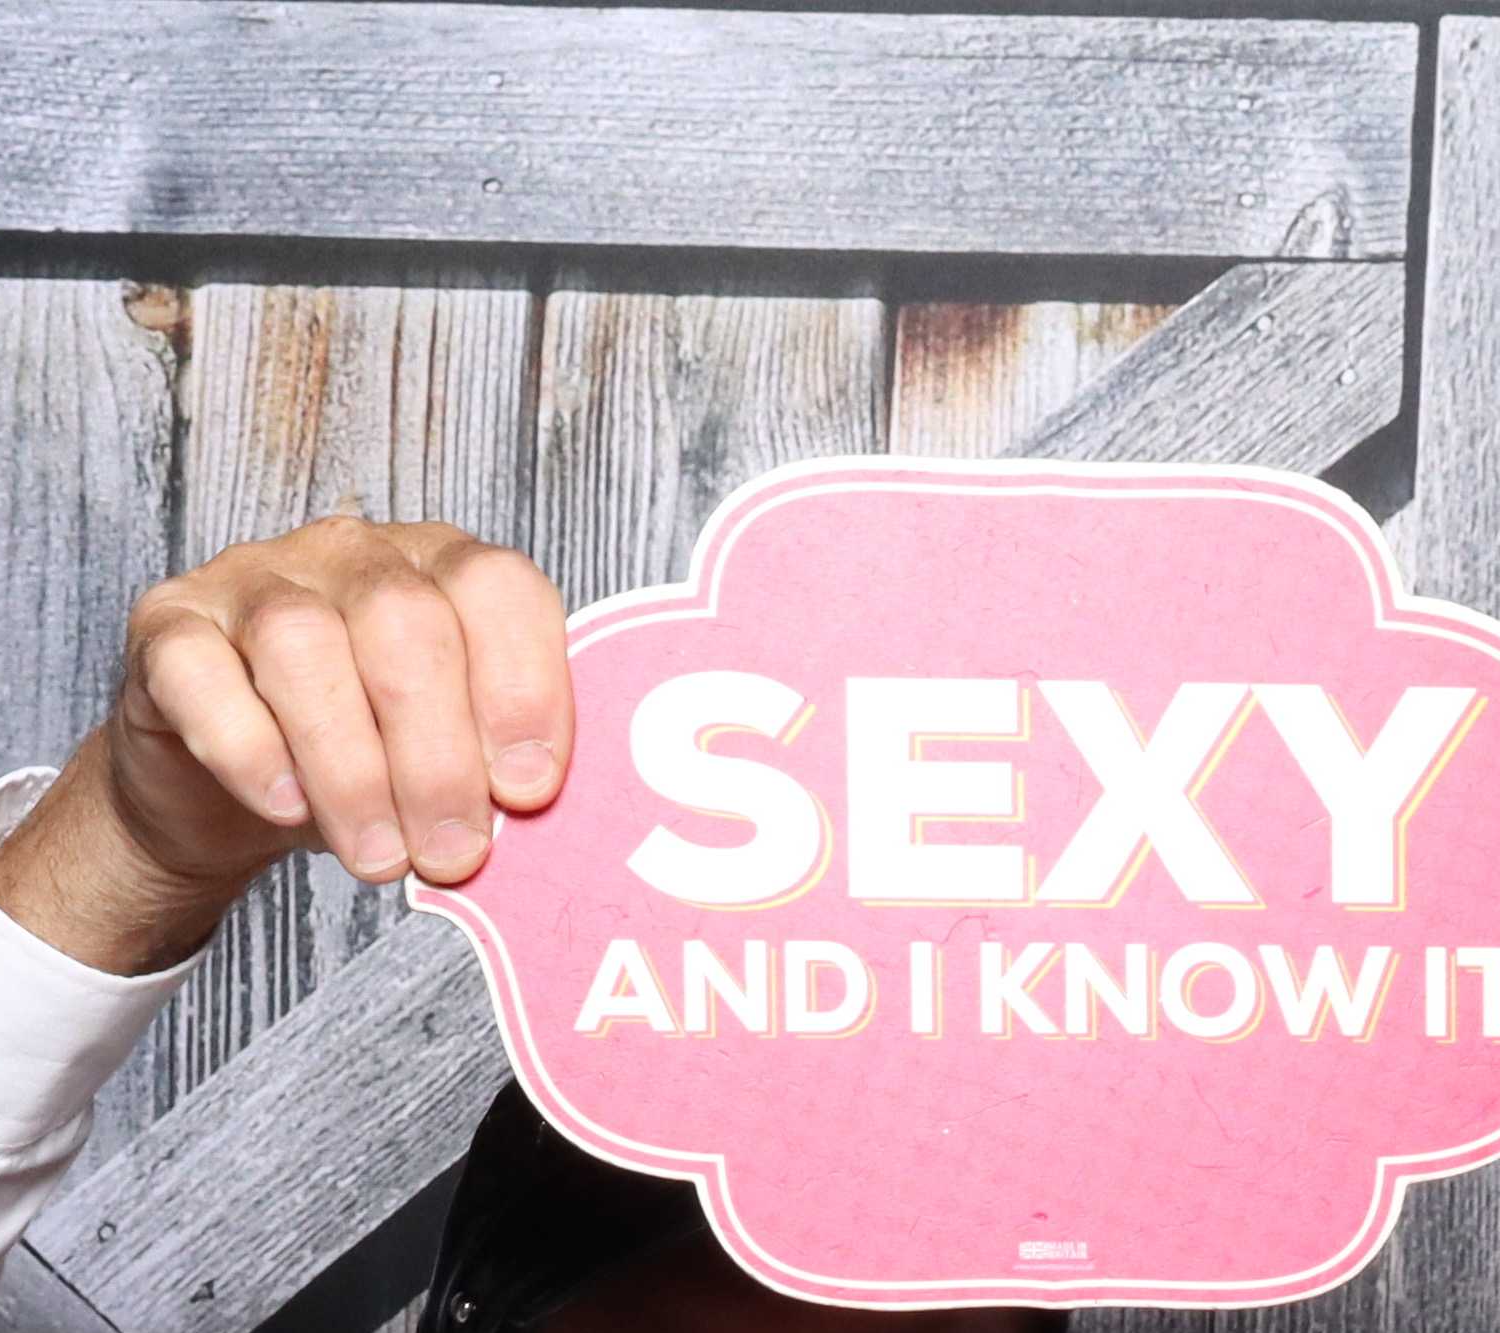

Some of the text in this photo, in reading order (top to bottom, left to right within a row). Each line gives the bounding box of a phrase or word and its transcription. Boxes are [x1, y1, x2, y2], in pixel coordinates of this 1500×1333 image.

[624, 669, 1486, 909] SEXY
[572, 939, 874, 1037] AND
[909, 941, 941, 1038] I
[979, 942, 1396, 1040] KNOW
